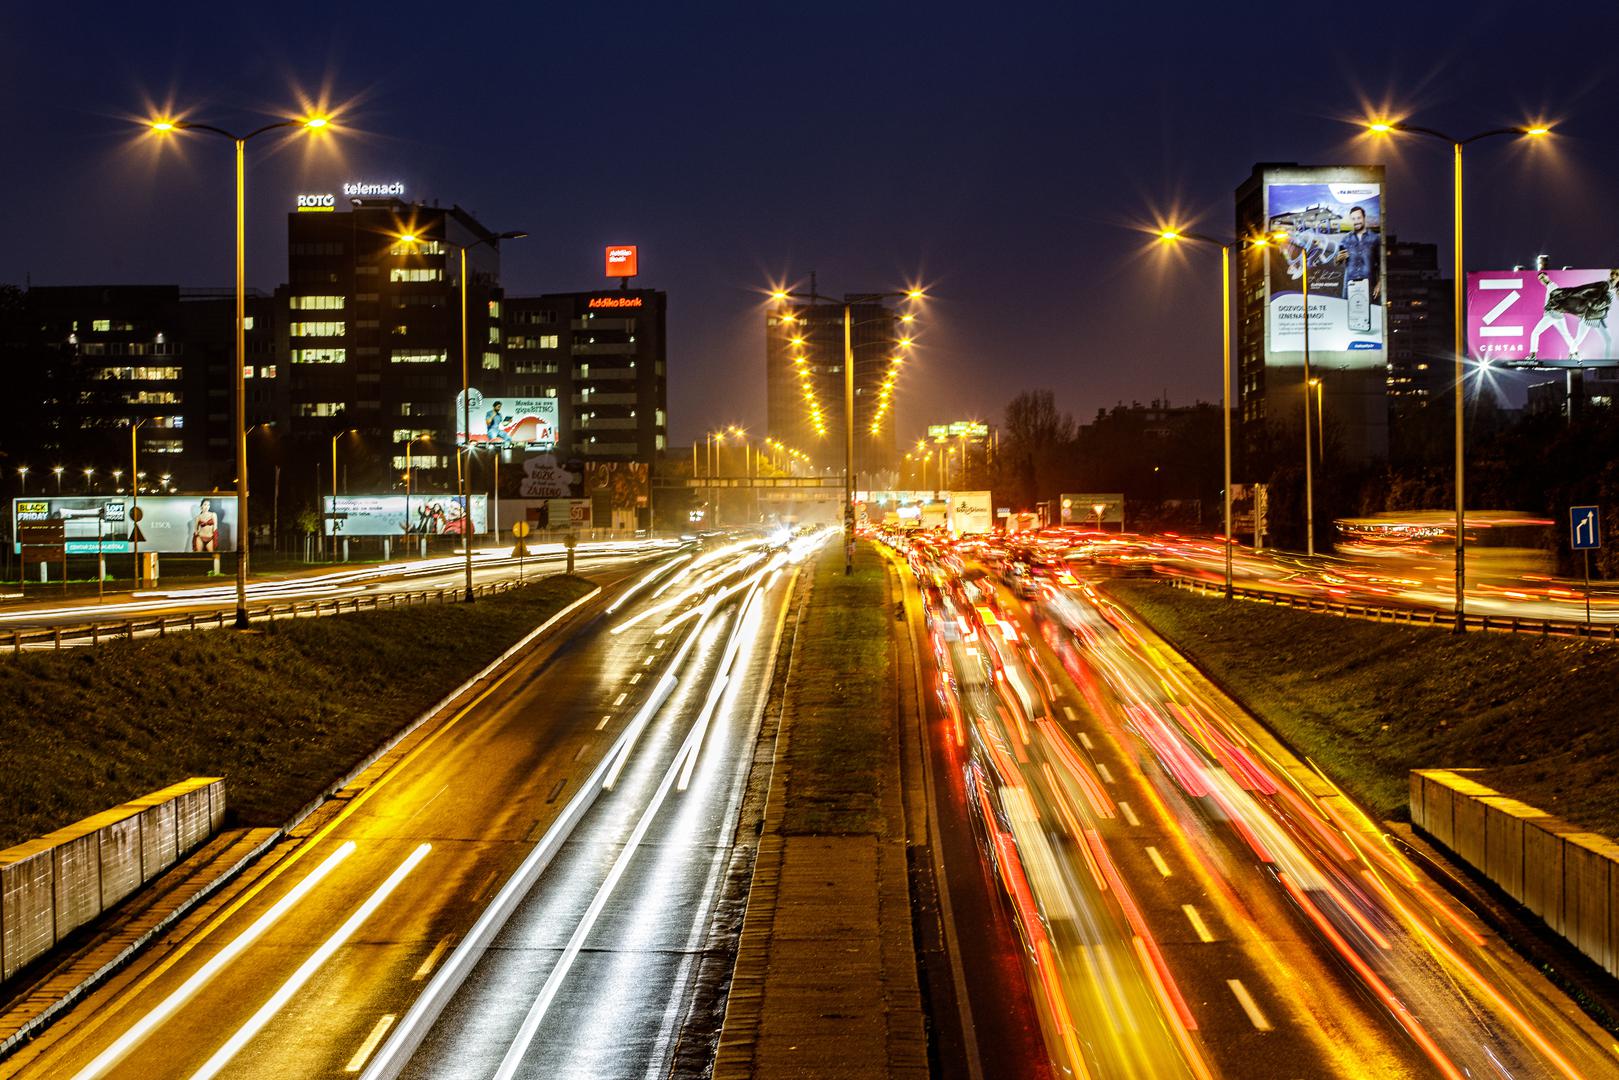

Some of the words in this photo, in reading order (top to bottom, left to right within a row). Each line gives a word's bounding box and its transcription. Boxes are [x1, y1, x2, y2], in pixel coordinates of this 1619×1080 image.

[343, 182, 404, 195] telemach
[297, 194, 335, 207] ROTO
[588, 298, 619, 308] Addiko
[620, 297, 642, 307] Bank
[1479, 344, 1524, 352] CENTAR
[541, 426, 552, 439] A1
[17, 512, 48, 520] FRIDAY
